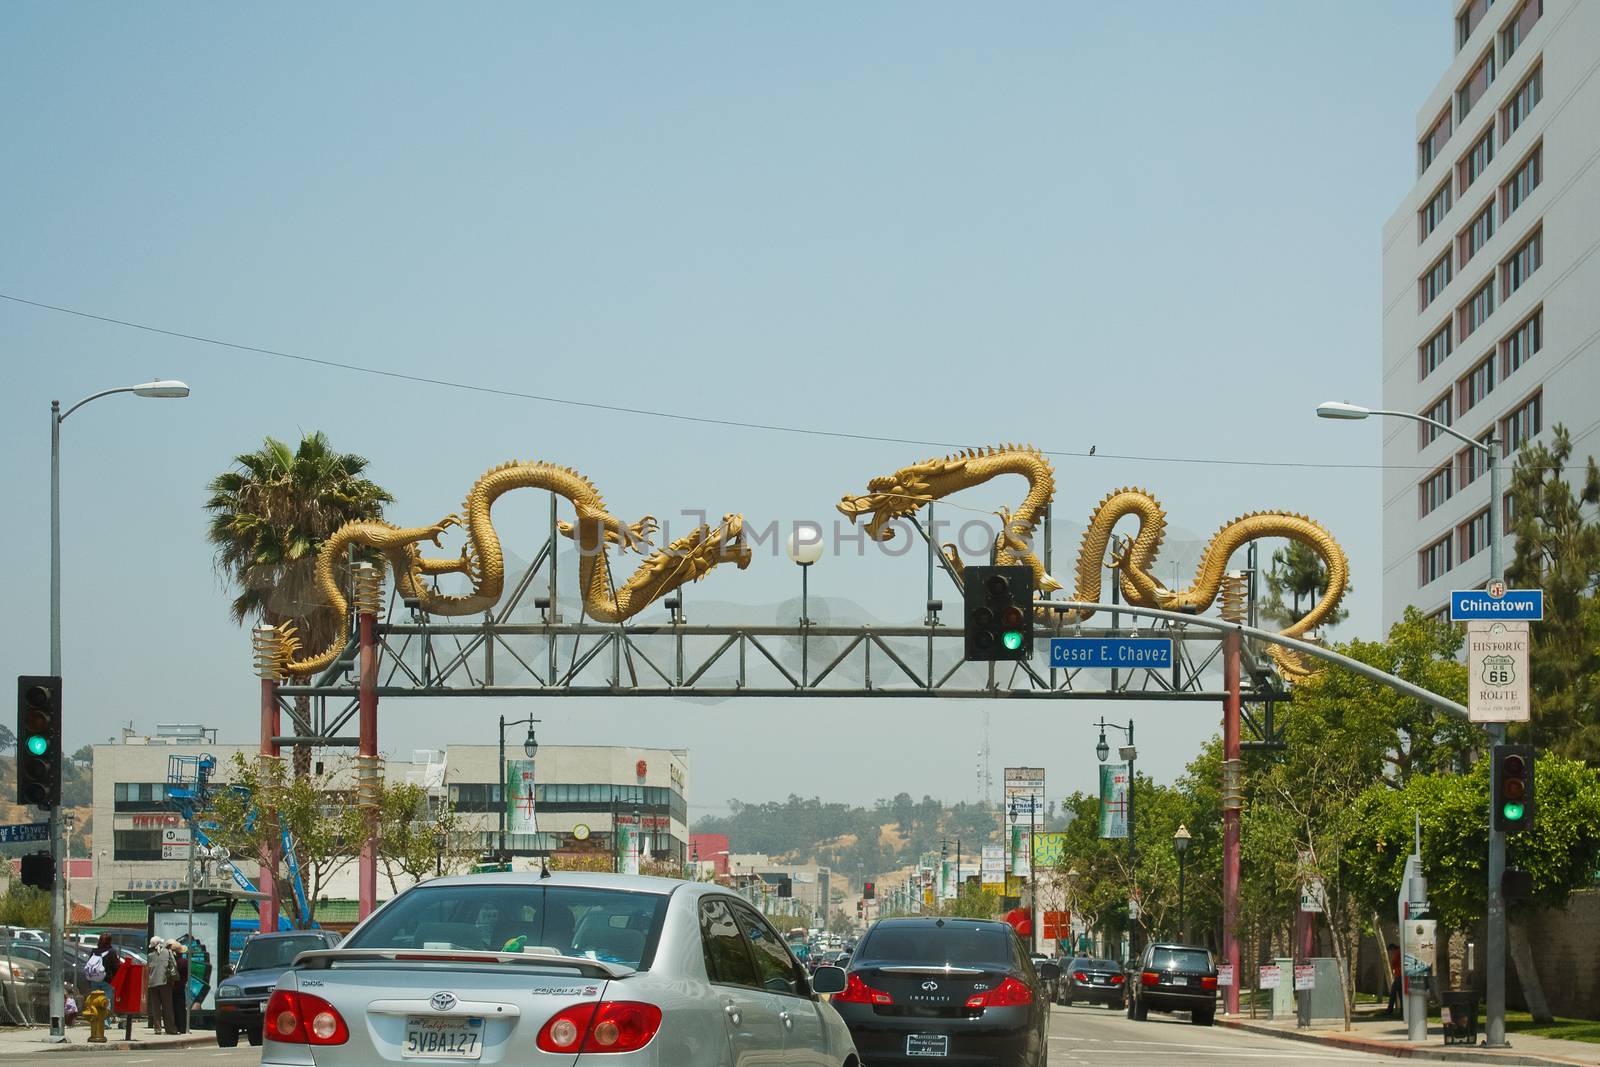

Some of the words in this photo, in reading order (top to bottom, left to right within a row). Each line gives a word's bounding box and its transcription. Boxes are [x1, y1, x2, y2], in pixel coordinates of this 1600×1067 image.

[1460, 599, 1534, 611] Chinatown
[1473, 642, 1525, 651] HISTORIC
[1054, 645, 1093, 661] Cesar
[1101, 645, 1113, 661] E.
[1118, 645, 1167, 661] Chavez
[1489, 671, 1508, 682] 66
[1480, 691, 1518, 700] ROUTE
[422, 1020, 468, 1031] California
[408, 1031, 478, 1053] 5VBA127
